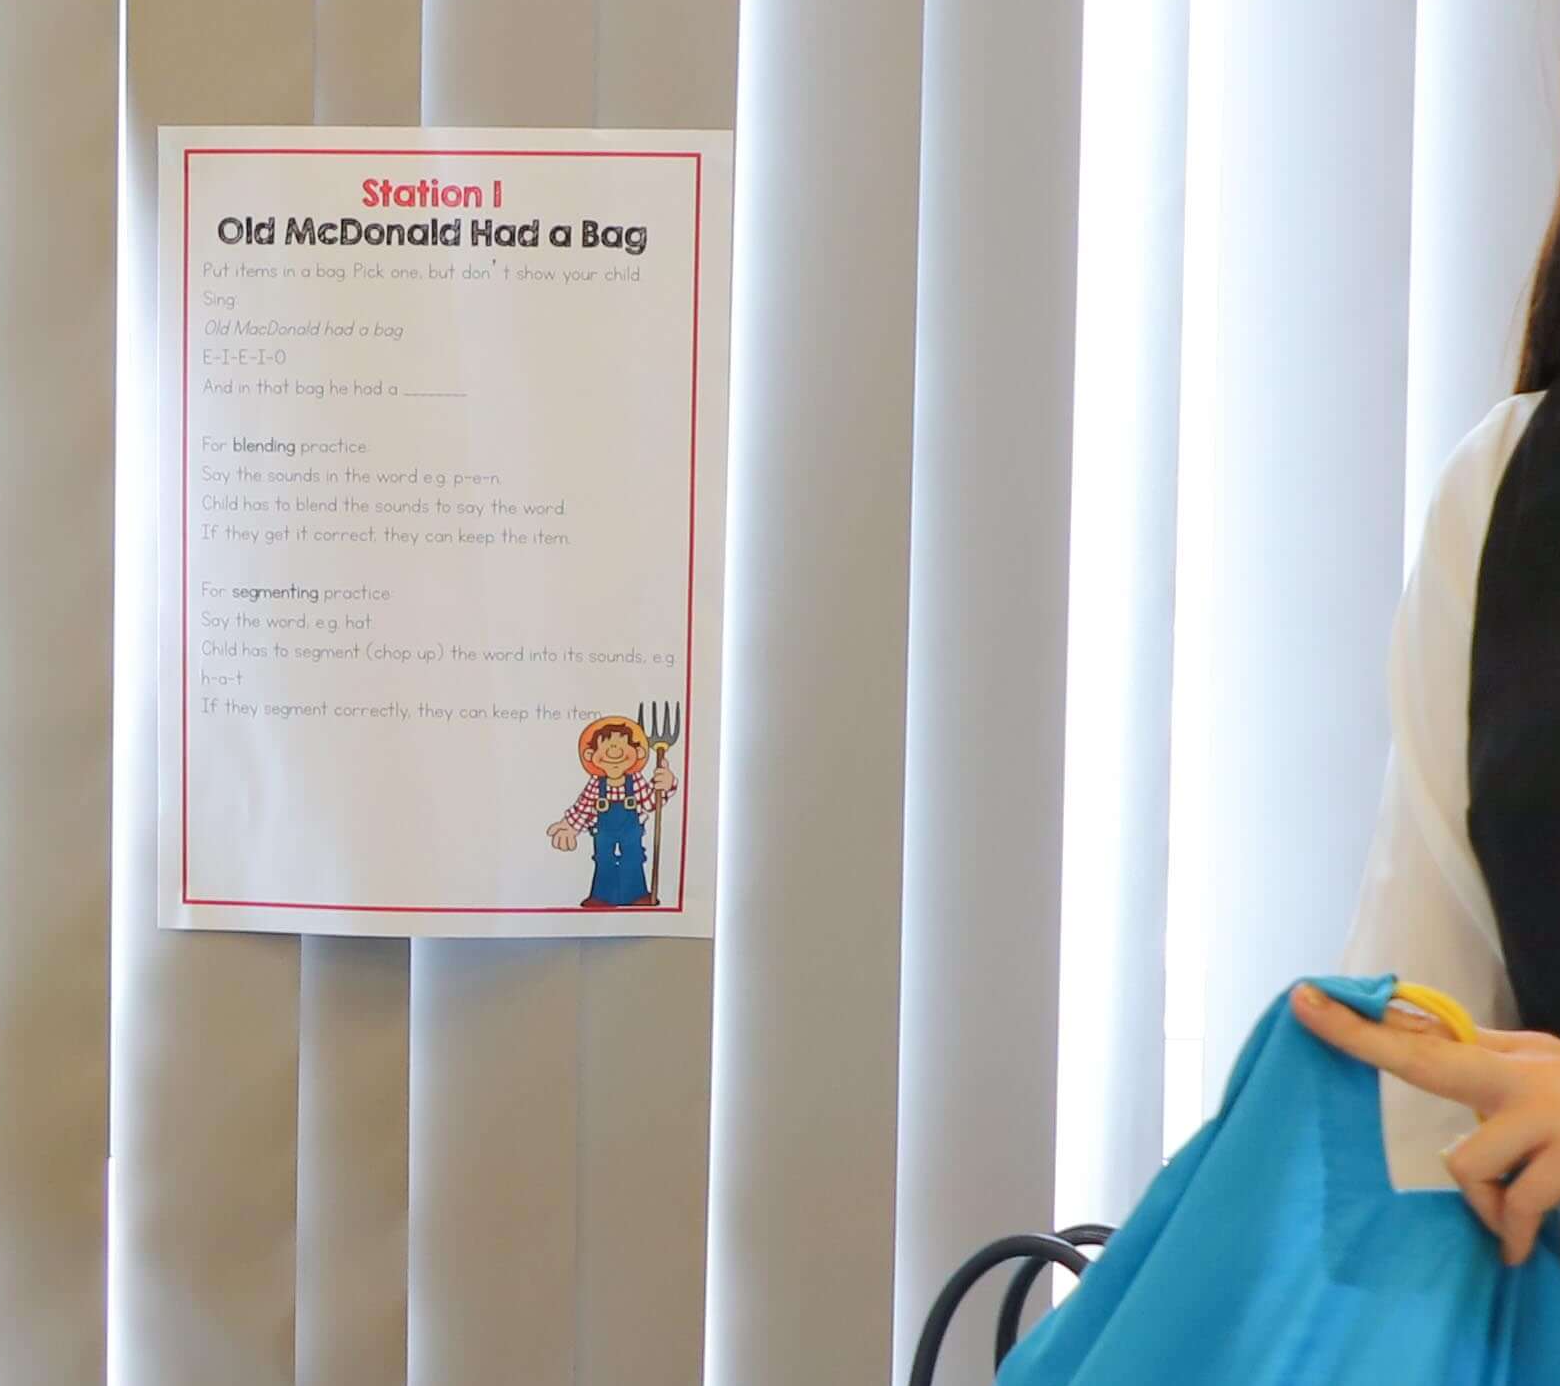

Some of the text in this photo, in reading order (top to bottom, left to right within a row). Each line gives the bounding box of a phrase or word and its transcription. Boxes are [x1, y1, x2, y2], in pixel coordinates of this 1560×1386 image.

[362, 179, 482, 208] Station
[218, 217, 647, 255] Old McDonald Had a Bag
[203, 261, 230, 277] Put
[236, 262, 277, 278] items
[283, 266, 295, 277] in
[301, 269, 312, 277] a
[354, 262, 384, 279] Pick
[429, 263, 455, 279] but
[516, 264, 555, 280] show
[562, 269, 598, 285] your
[205, 319, 231, 335] Old
[234, 320, 321, 336] MacDonald
[324, 320, 355, 336] had
[359, 326, 369, 337] a
[203, 349, 286, 365] E-I-E-I-O
[203, 378, 398, 399] And in that bag he had a
[202, 436, 227, 452] For
[233, 437, 295, 457] blending
[202, 465, 230, 485] Say
[236, 466, 261, 482] the
[268, 467, 320, 485] sounds
[326, 469, 338, 483] in
[344, 467, 370, 483] the
[377, 468, 417, 484] word
[202, 495, 238, 511] Child
[243, 496, 269, 511] has
[275, 496, 290, 511] to
[296, 496, 337, 513] blend
[343, 496, 369, 512] the
[376, 498, 429, 514] sounds
[435, 498, 451, 514] to
[457, 503, 485, 517] say
[491, 499, 517, 515] the
[201, 524, 219, 540] If
[225, 525, 259, 544] they
[265, 526, 290, 545] get
[297, 526, 308, 541] it
[384, 527, 419, 546] they
[425, 533, 453, 543] can
[458, 528, 496, 547] keep
[502, 528, 528, 544] the
[202, 582, 226, 597] For
[232, 583, 319, 603] segmenting
[201, 611, 229, 631] Say
[236, 613, 260, 629] the
[200, 640, 237, 659] Child
[242, 642, 267, 657] has
[273, 642, 288, 657] to
[295, 643, 360, 662] segment
[366, 641, 411, 663] (chop
[417, 643, 444, 664] up)
[450, 645, 477, 661] the
[483, 646, 524, 661] word
[530, 646, 557, 662] into
[564, 647, 583, 662] its
[201, 697, 219, 713] If
[224, 699, 257, 718] they
[265, 701, 328, 719] segment
[417, 702, 453, 722] they
[459, 709, 488, 719] can
[493, 703, 528, 723] keep
[536, 704, 561, 720] the
